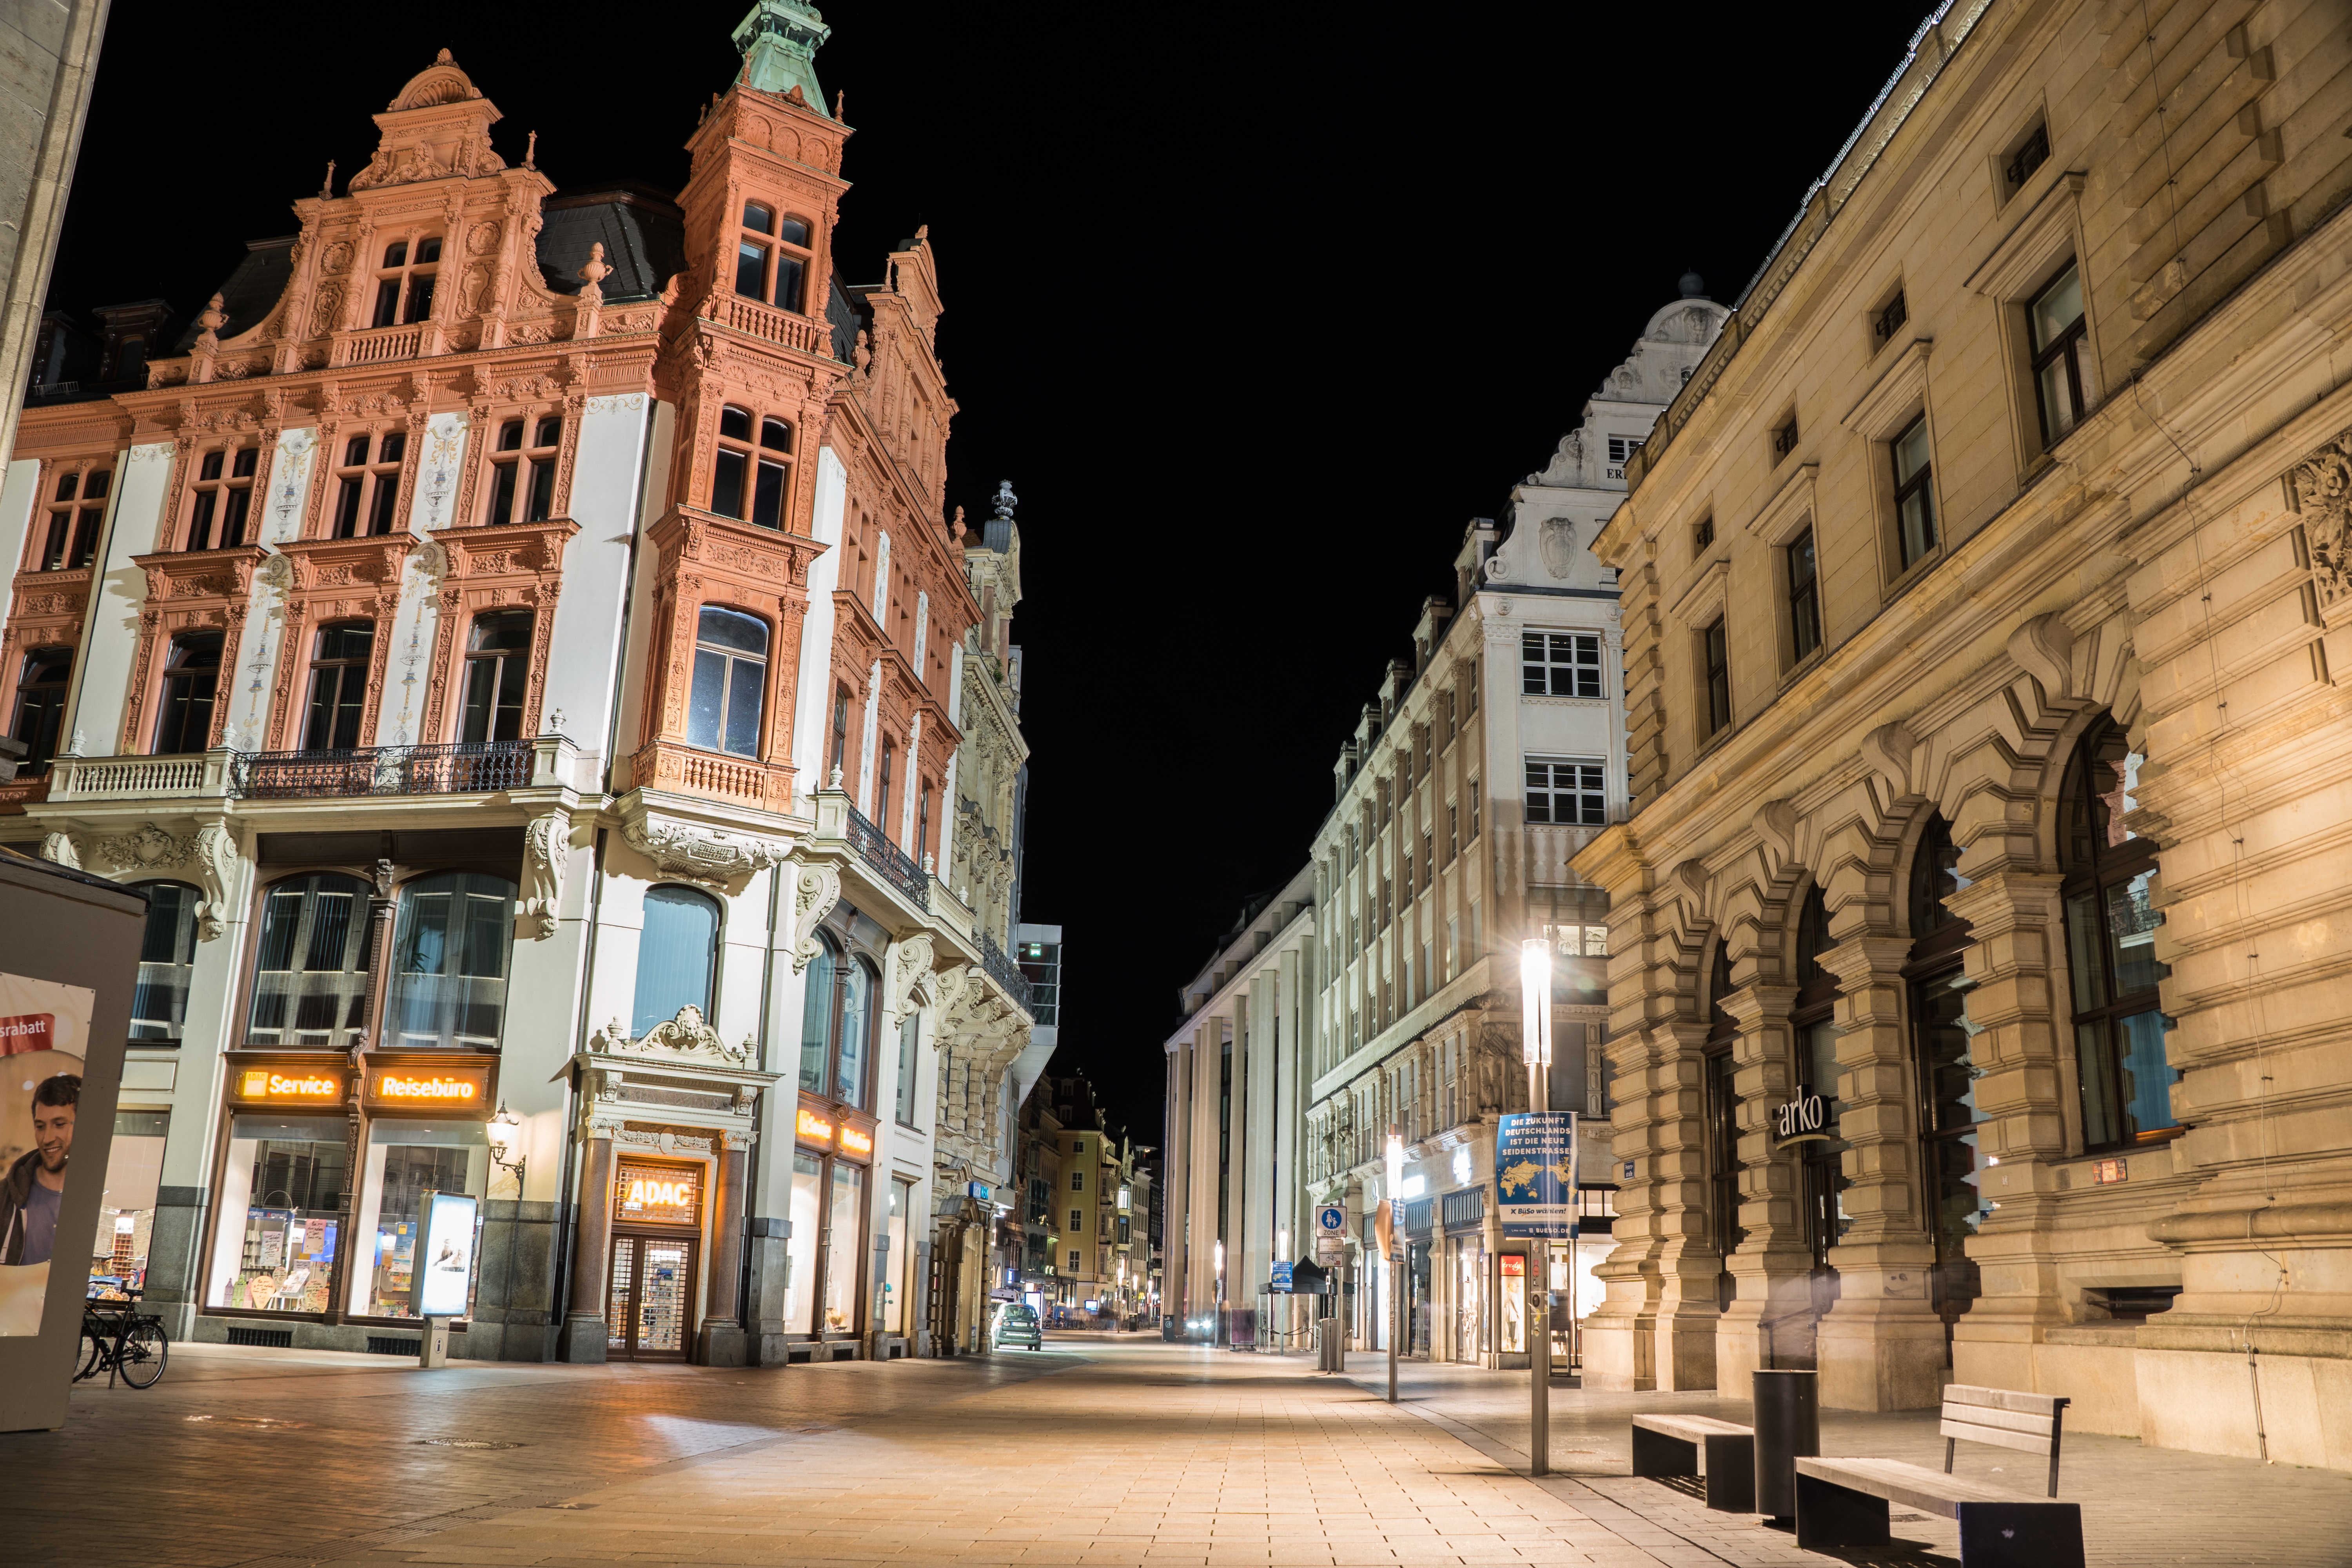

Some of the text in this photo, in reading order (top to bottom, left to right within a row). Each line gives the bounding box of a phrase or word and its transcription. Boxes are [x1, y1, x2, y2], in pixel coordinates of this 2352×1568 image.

[269, 1074, 335, 1095] Service
[382, 1077, 474, 1098] Reisebüro
[1780, 1084, 1822, 1136] arko
[1505, 1127, 1570, 1136] DEUTSCHLANDS
[630, 1180, 690, 1206] ADAC
